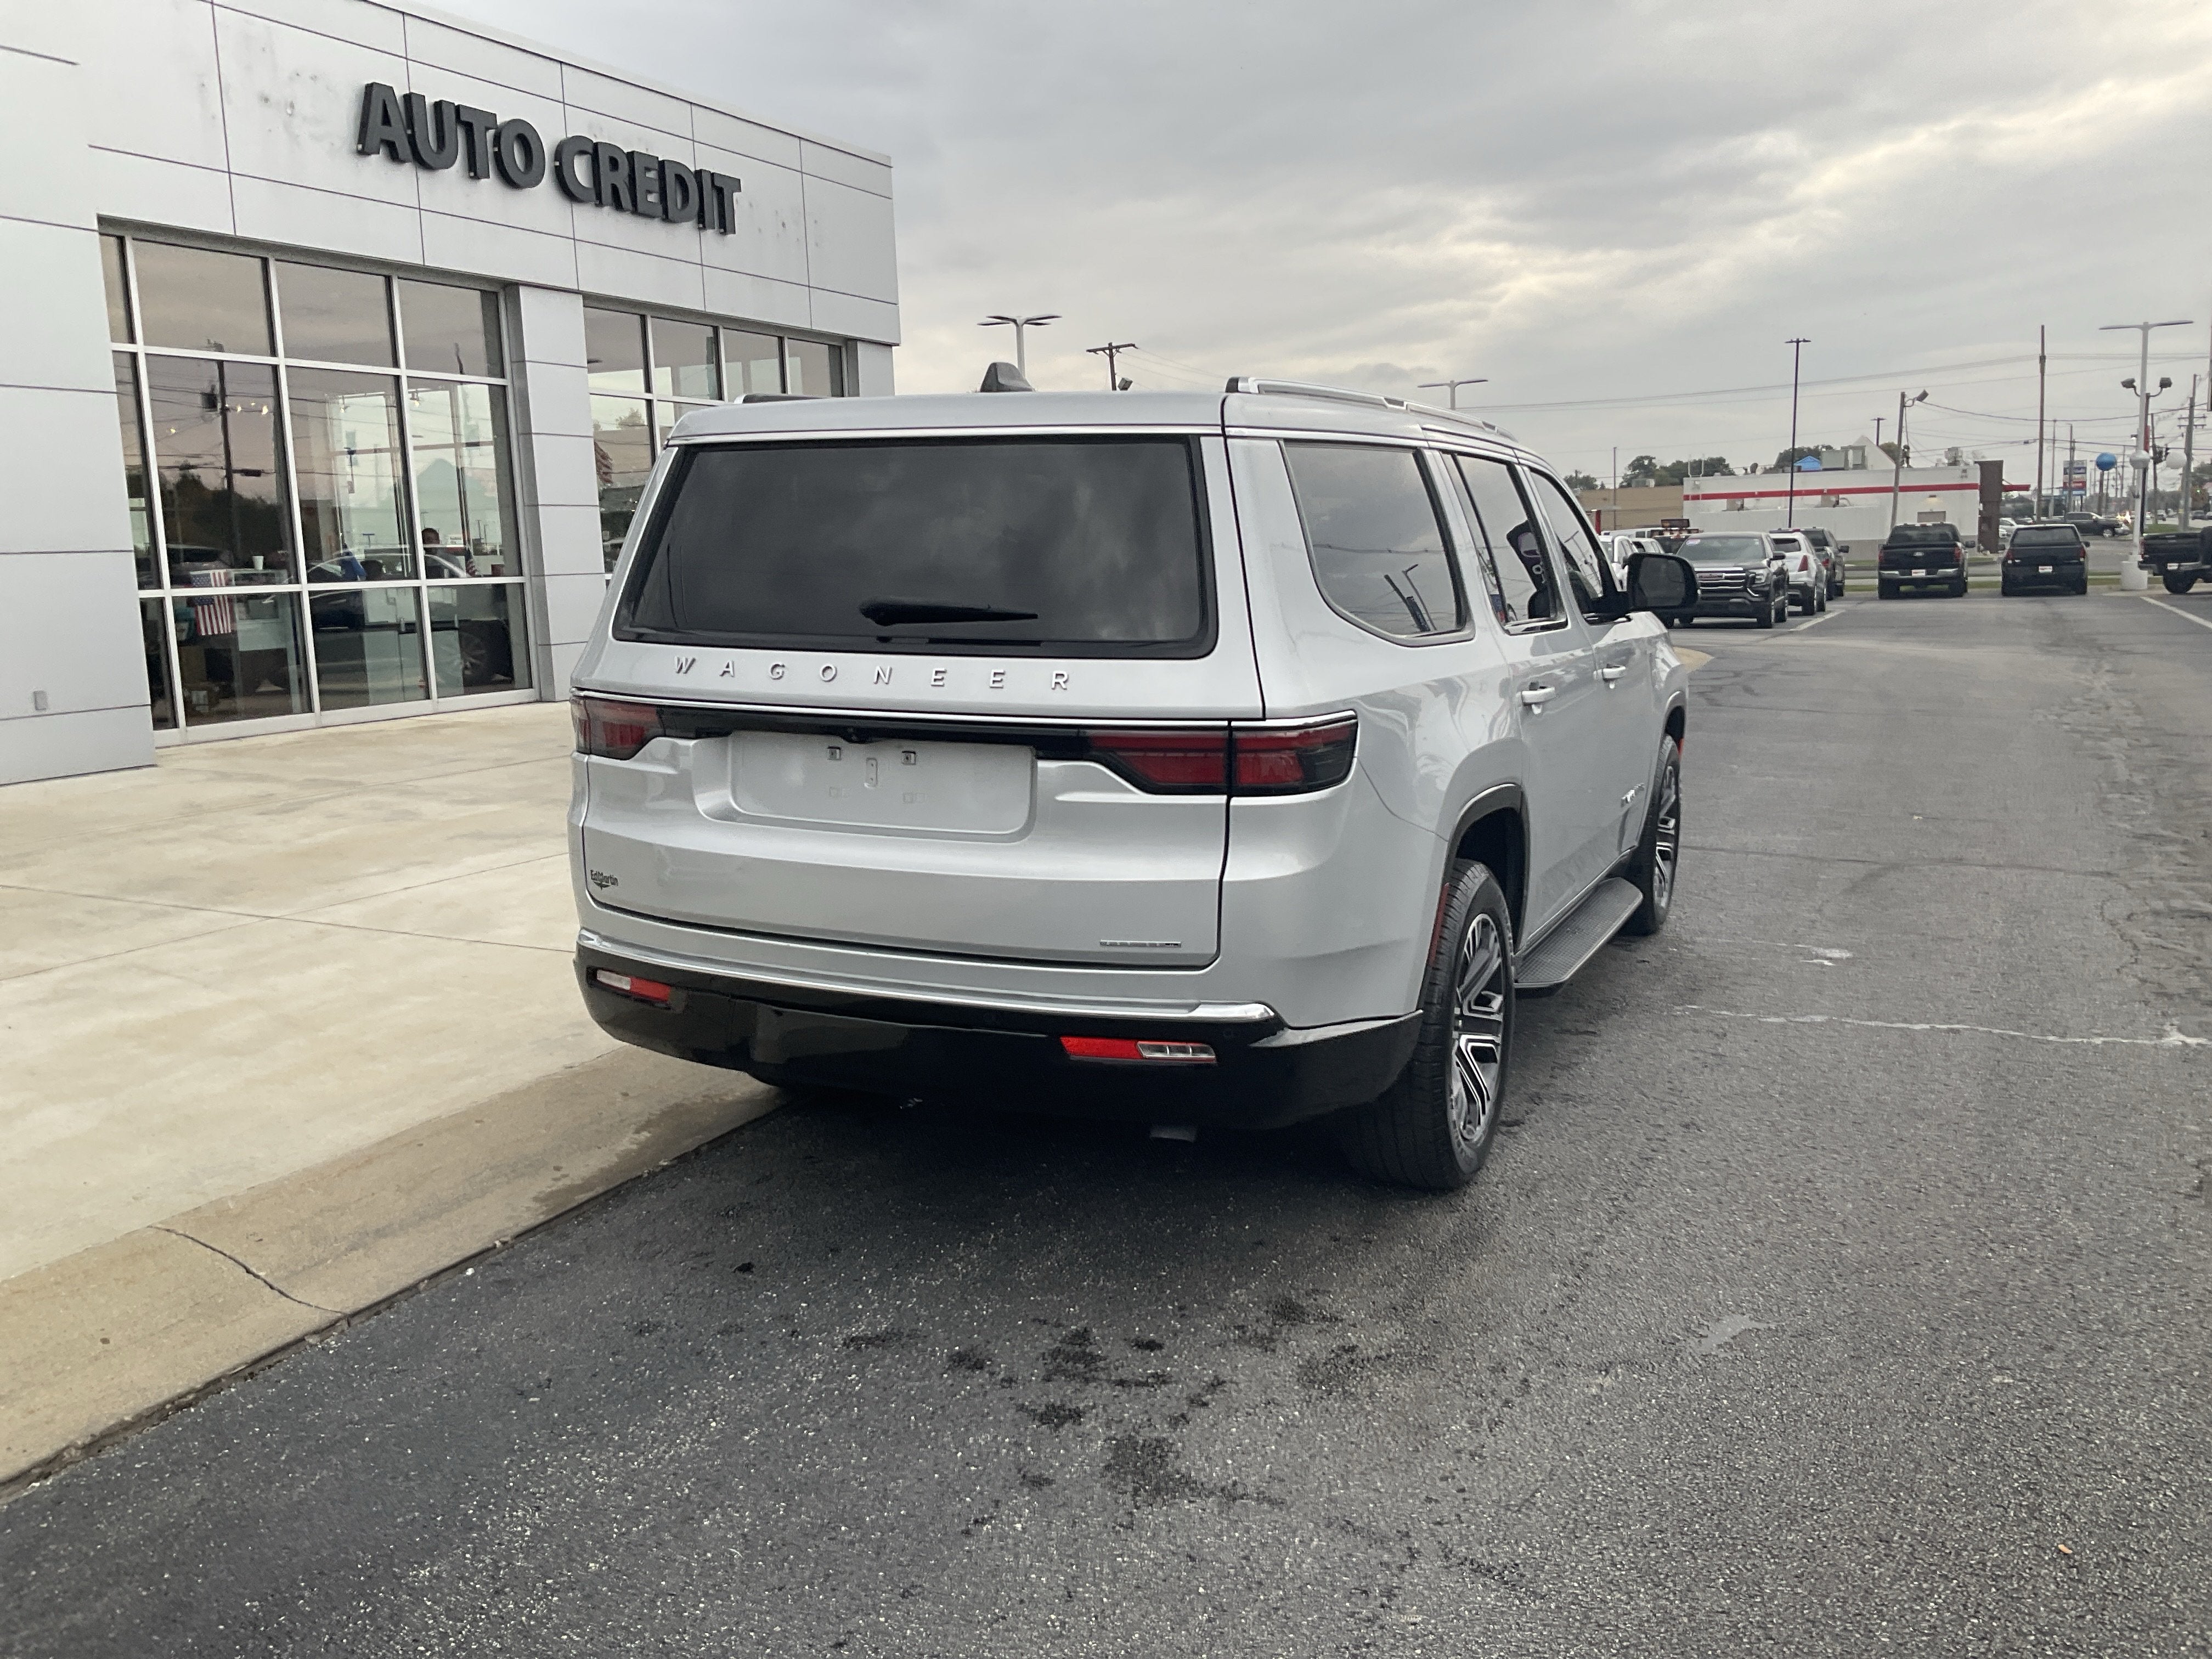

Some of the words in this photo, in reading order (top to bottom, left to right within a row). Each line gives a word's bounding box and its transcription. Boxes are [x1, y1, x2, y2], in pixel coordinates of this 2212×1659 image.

[357, 82, 546, 189] AUTO
[554, 135, 741, 234] CREDIT
[673, 656, 1070, 690] WAGONEER
